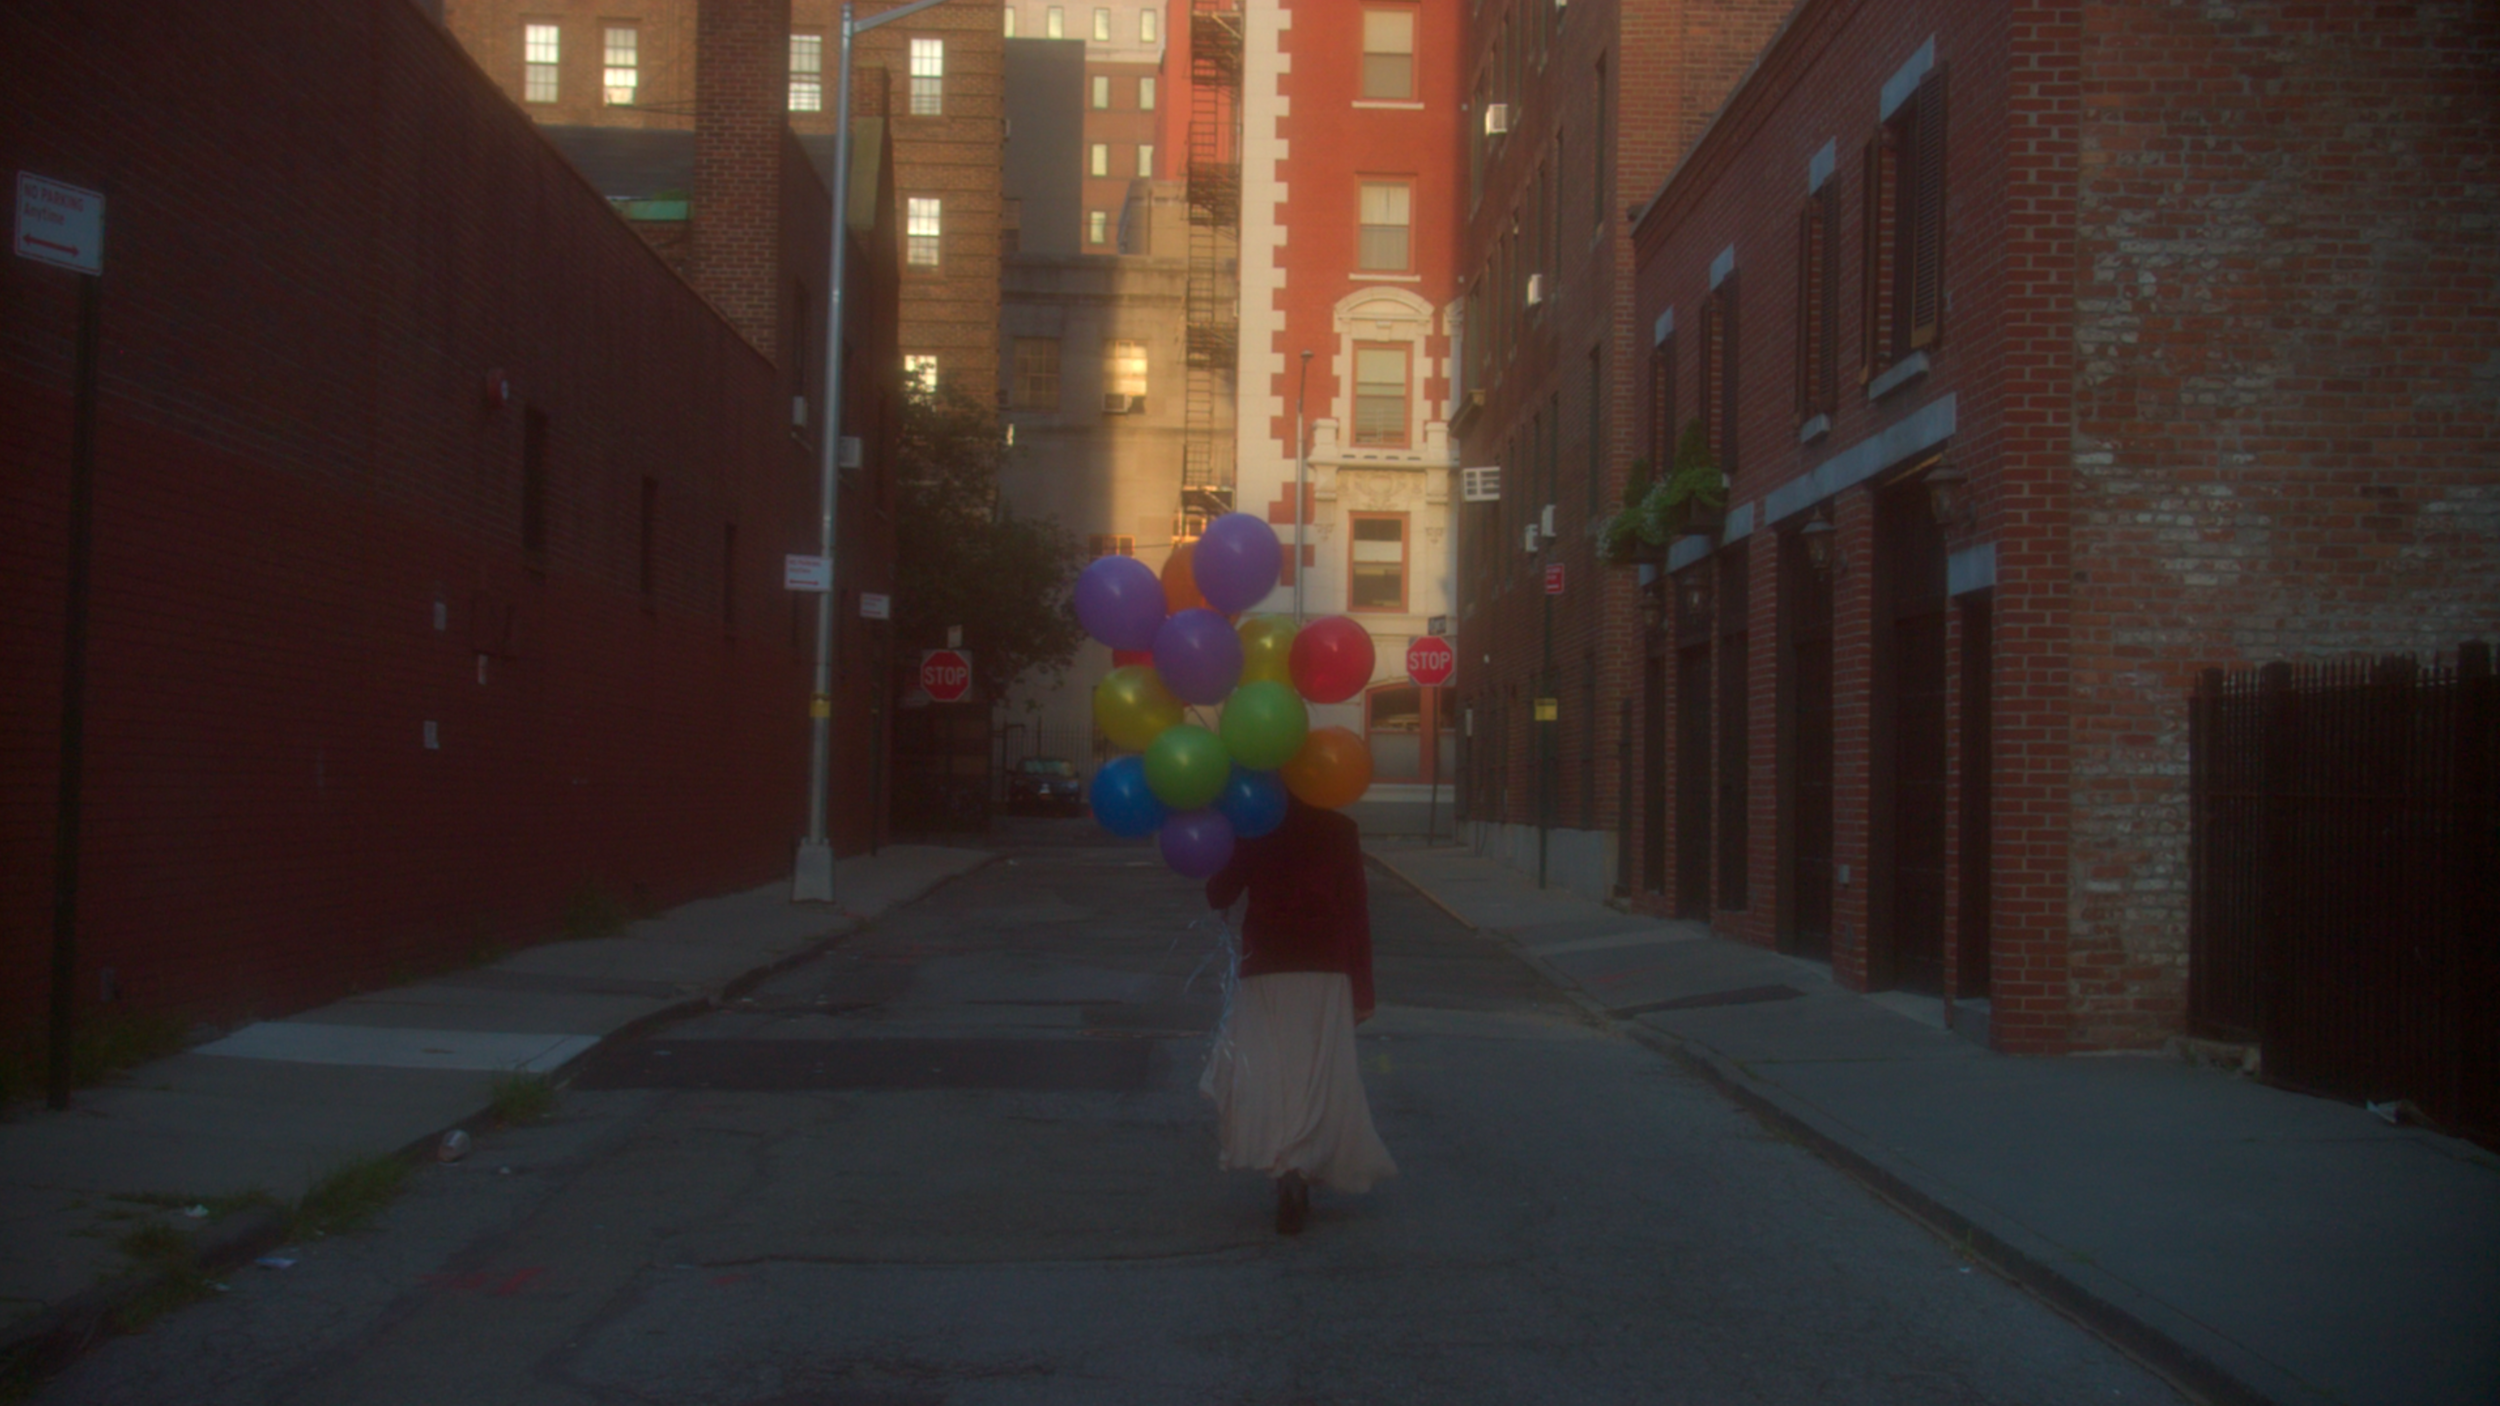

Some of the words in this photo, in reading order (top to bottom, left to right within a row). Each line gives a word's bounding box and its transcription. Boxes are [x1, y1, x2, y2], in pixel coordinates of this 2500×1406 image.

[24, 183, 38, 199] NO
[41, 187, 84, 212] PARKING
[24, 202, 65, 225] Anytime
[1409, 651, 1450, 670] STOP
[924, 666, 967, 685] STOP
